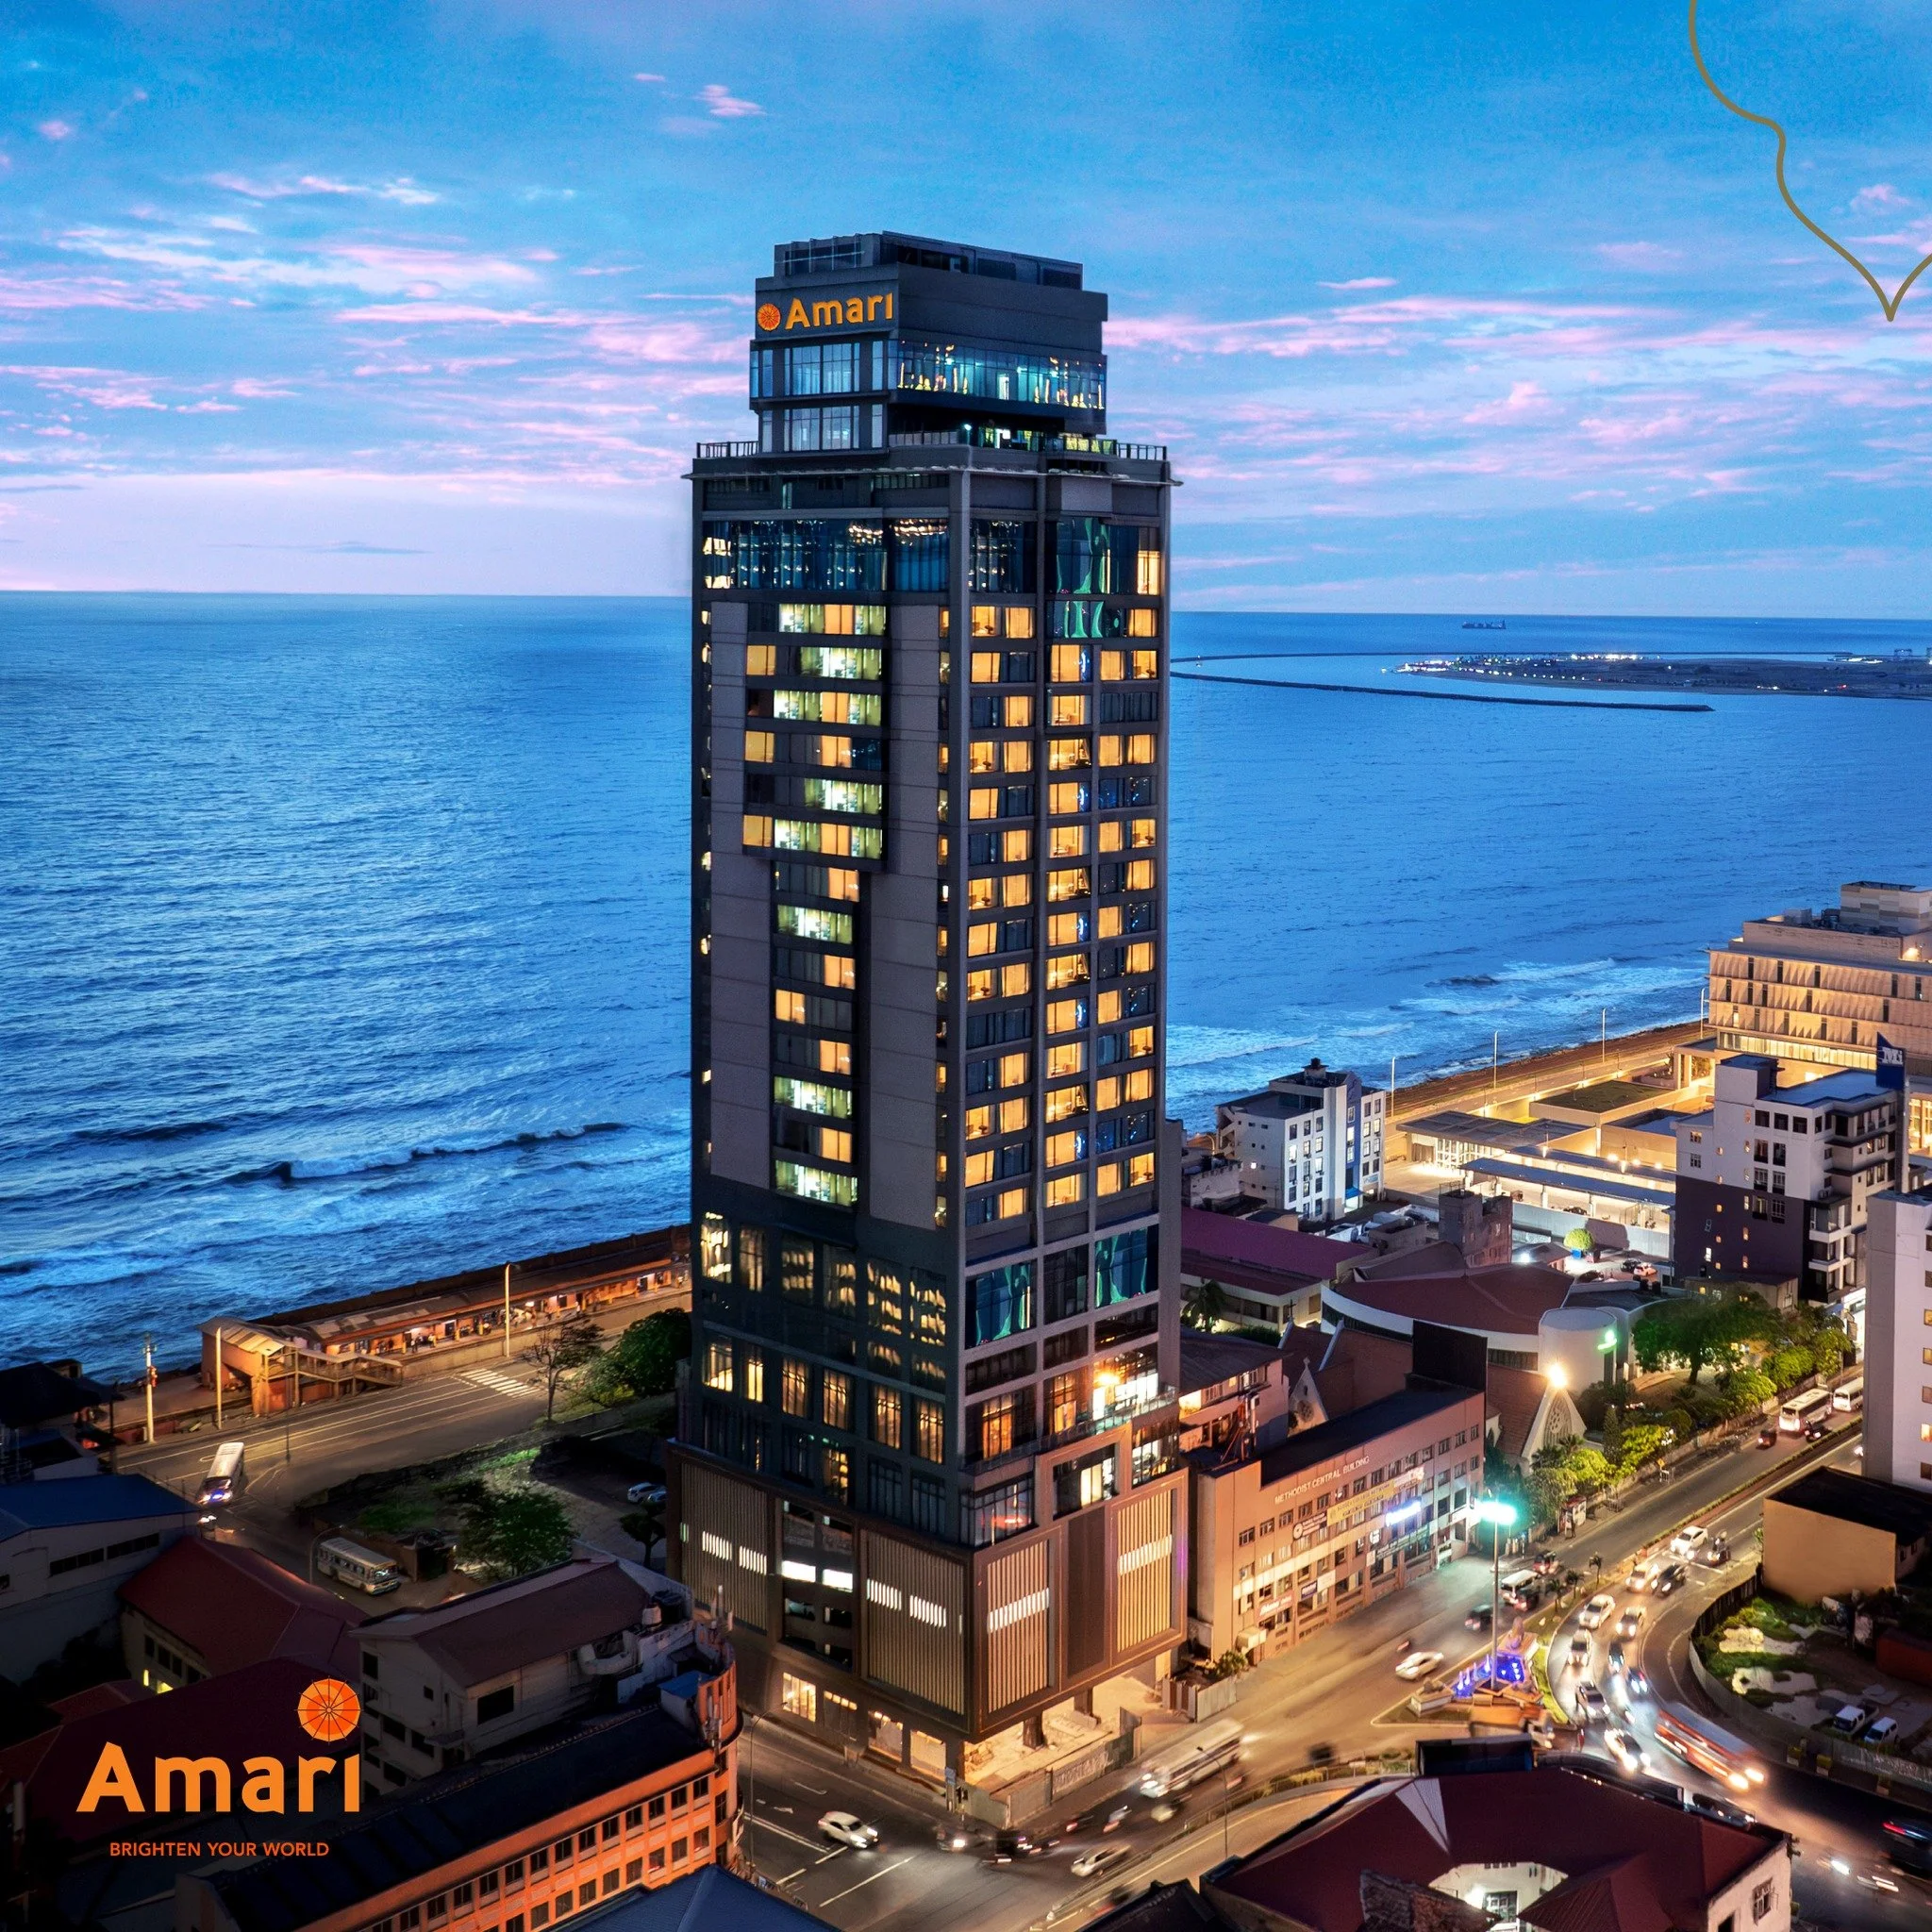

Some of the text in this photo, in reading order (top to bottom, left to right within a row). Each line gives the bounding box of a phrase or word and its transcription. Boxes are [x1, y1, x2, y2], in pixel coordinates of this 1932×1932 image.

[785, 291, 893, 330] Amari
[1274, 1456, 1370, 1505] METHODIST CENTRAL BUILDING
